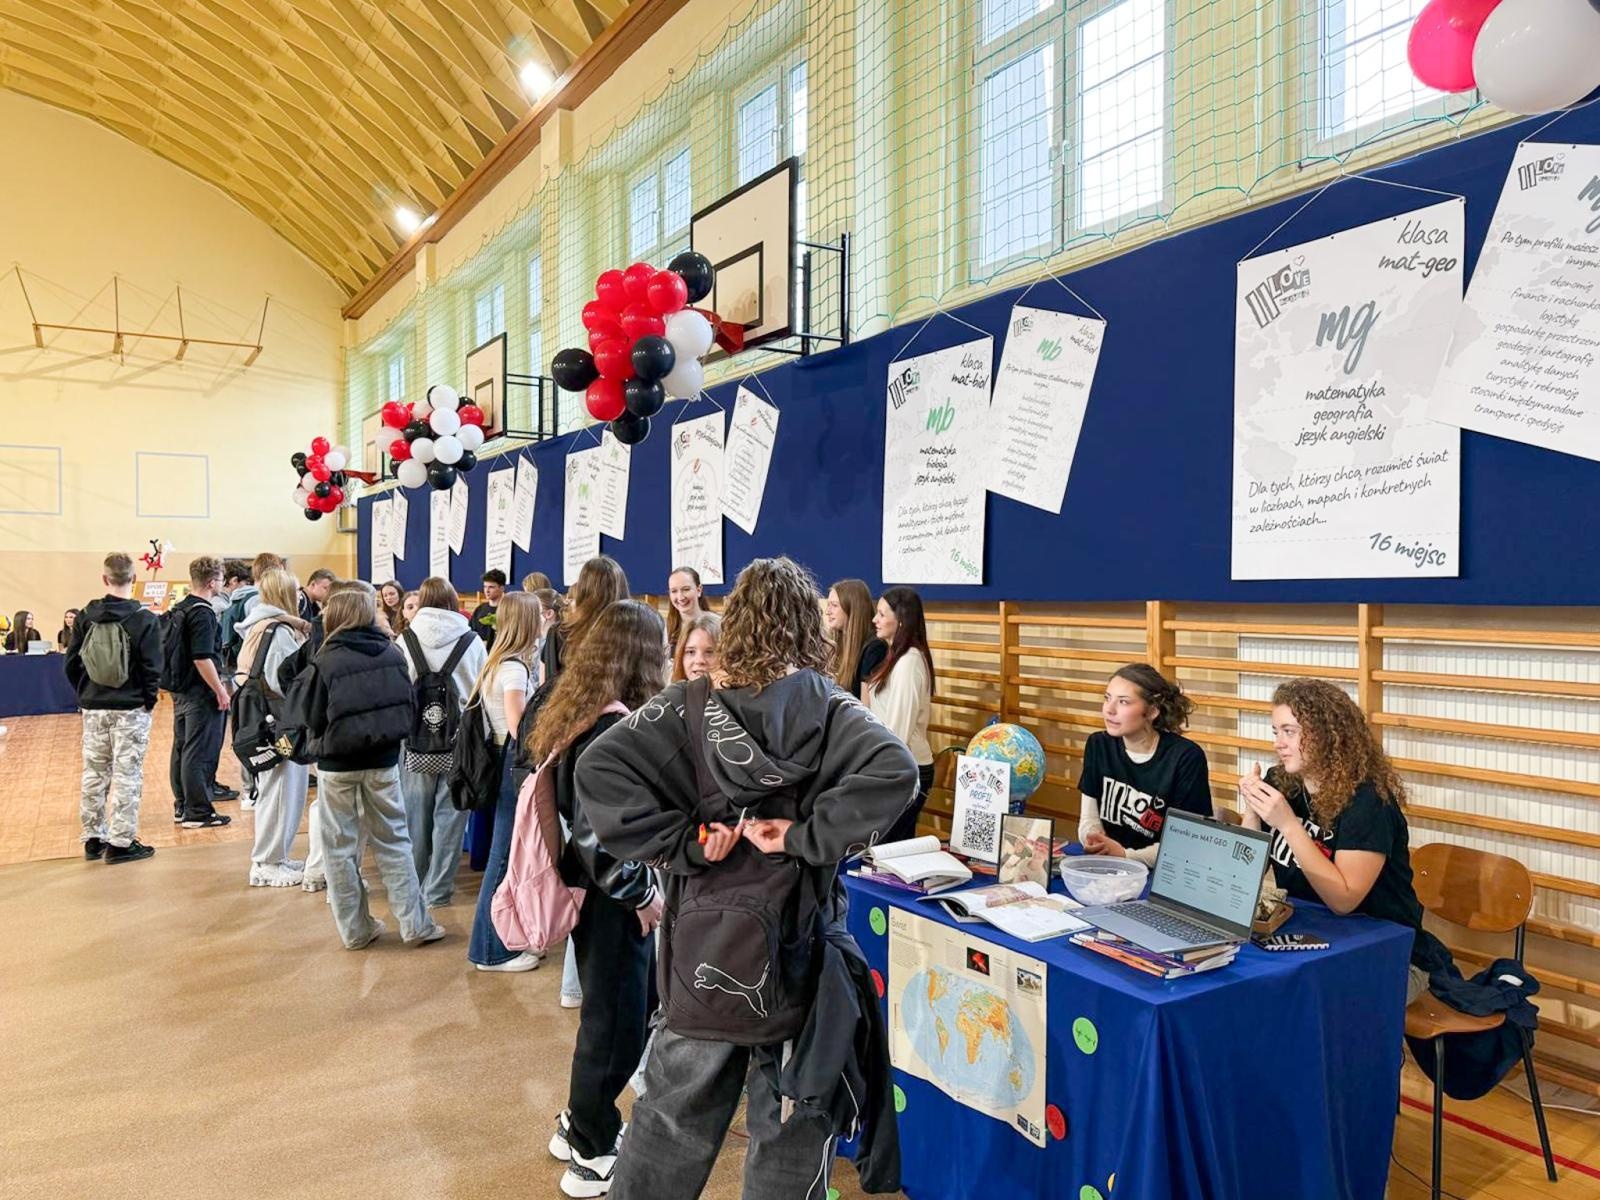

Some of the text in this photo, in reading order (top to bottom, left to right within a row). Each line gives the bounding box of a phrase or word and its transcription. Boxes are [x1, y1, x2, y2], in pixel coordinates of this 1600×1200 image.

[1397, 219, 1449, 244] klasa
[1501, 231, 1513, 244] Po
[1514, 234, 1532, 248] tym
[1532, 237, 1564, 250] profilu
[1377, 250, 1458, 279] mat-geo
[1510, 287, 1547, 300] finanse
[1550, 274, 1595, 294] ekonomię
[1539, 308, 1580, 329] logistykę
[1315, 299, 1382, 376] mg
[1493, 321, 1545, 341] gospodarkę
[1036, 337, 1063, 361] mb
[1540, 344, 1595, 368] kartografię
[960, 353, 984, 371] klasa
[1543, 364, 1580, 381] danych
[1305, 380, 1386, 404] matematyka
[1535, 382, 1580, 401] rekreację
[925, 396, 955, 436] mb
[1313, 402, 1373, 425] geografia
[1473, 403, 1519, 423] transport
[1295, 424, 1387, 447] język angielski
[919, 442, 957, 459] matematyka
[1248, 449, 1449, 498] Dla tych, którzy chcą rozumieć świat
[1249, 473, 1433, 515] w liczbach, mapach i konkretnych
[1368, 532, 1447, 569] 16 miejsc
[1199, 833, 1214, 844] MAT
[1213, 837, 1228, 847] GEO
